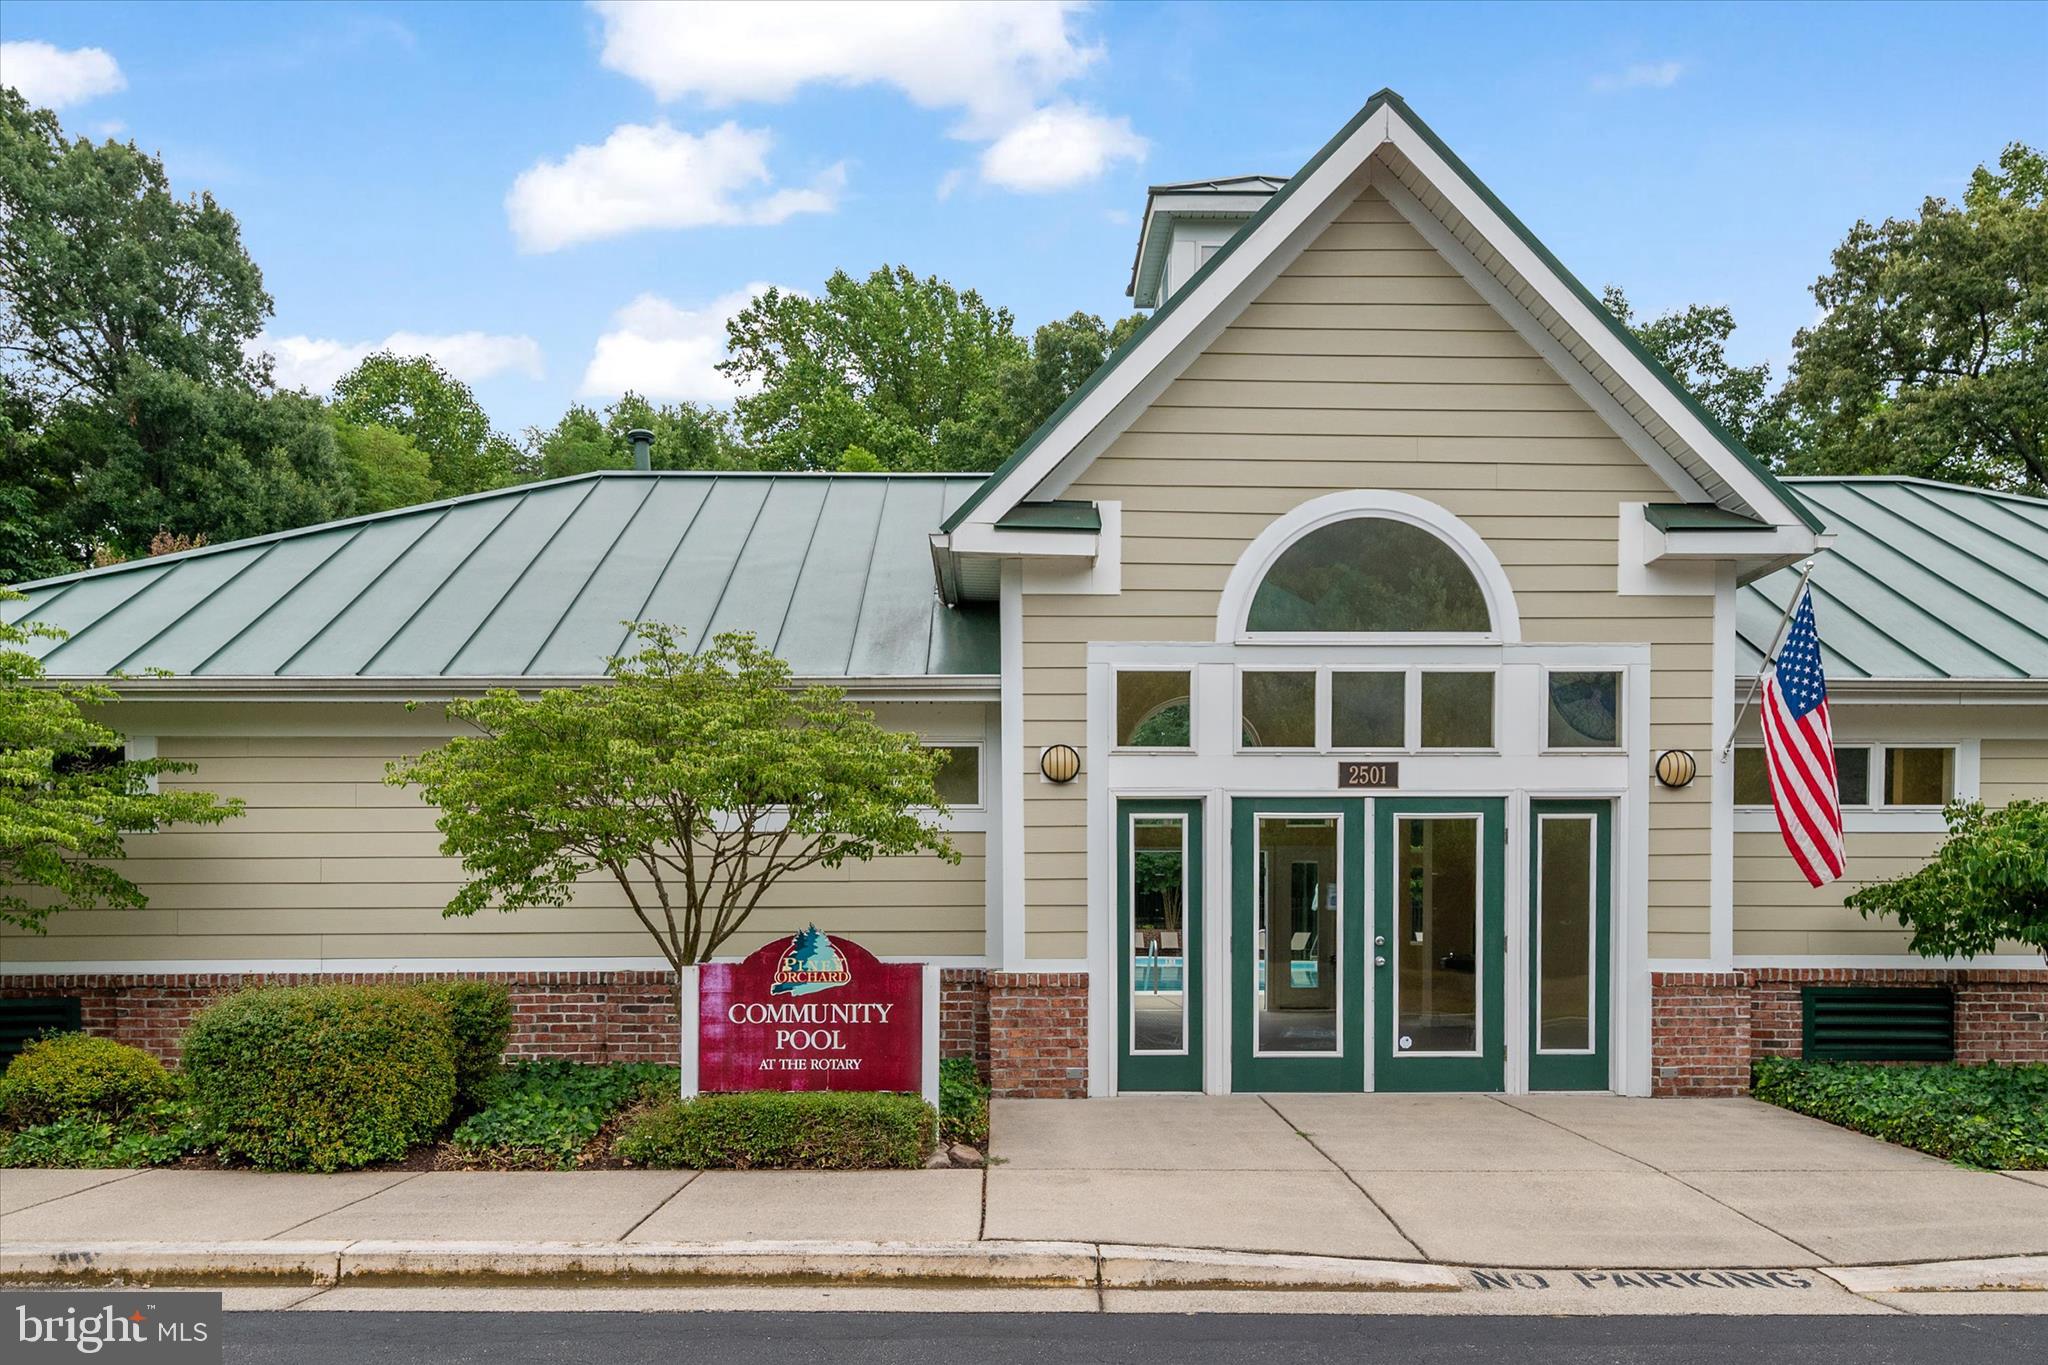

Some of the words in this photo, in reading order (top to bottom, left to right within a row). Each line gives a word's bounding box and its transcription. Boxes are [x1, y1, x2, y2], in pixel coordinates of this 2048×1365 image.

[1349, 766, 1387, 784] 2501
[777, 971, 848, 983] ORCHARD
[728, 1003, 893, 1024] COMMUNITY
[775, 1030, 846, 1050] POOL
[759, 1059, 777, 1070] AT
[778, 1059, 807, 1070] THE
[810, 1059, 862, 1070] ROTARY
[1470, 1270, 1550, 1290] NO
[1572, 1271, 1812, 1290] PARKING
